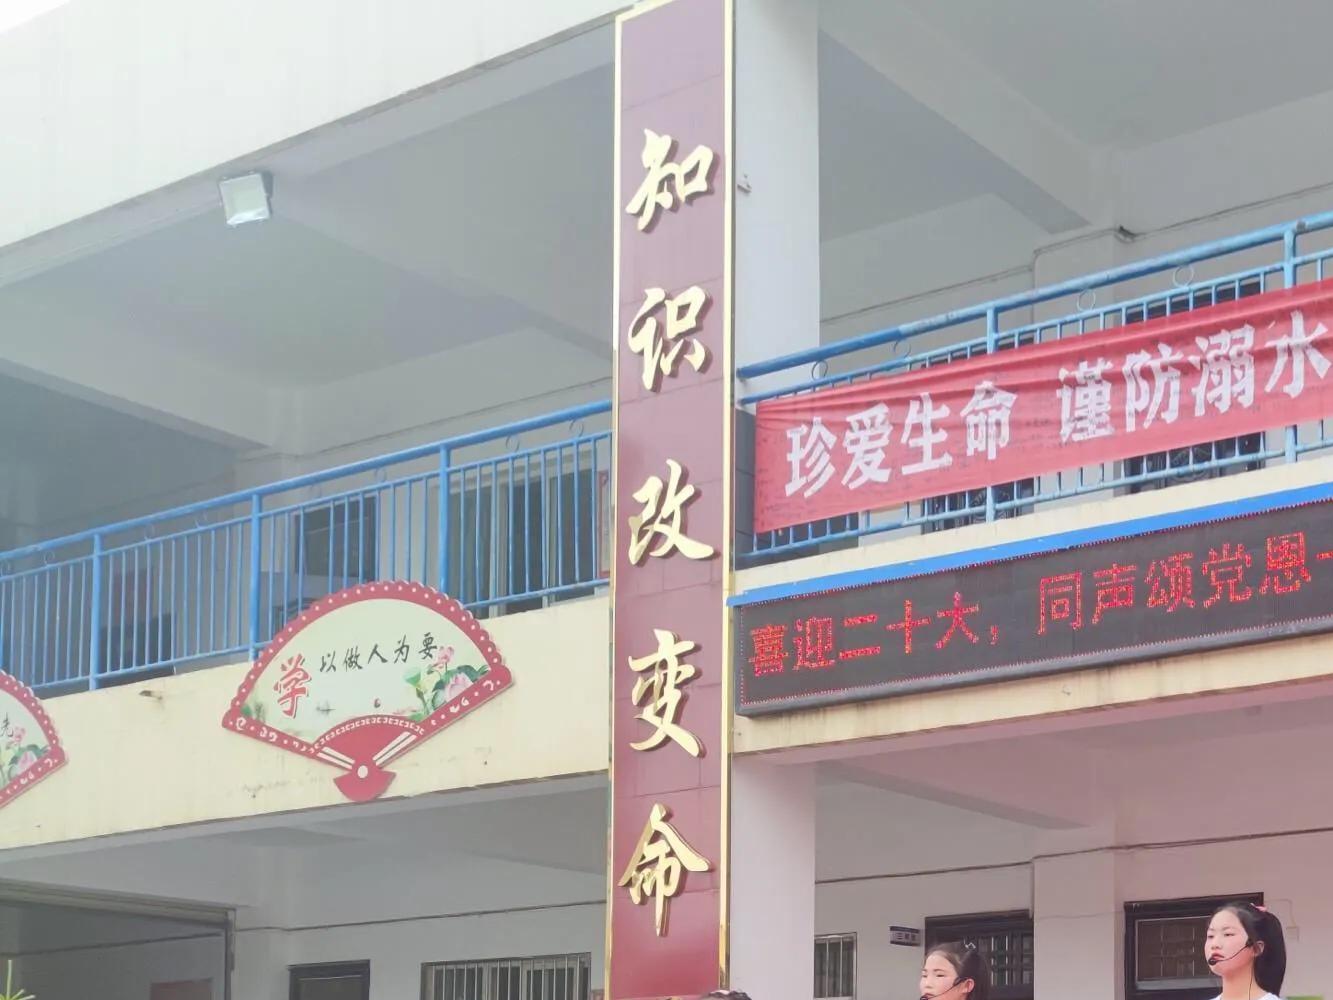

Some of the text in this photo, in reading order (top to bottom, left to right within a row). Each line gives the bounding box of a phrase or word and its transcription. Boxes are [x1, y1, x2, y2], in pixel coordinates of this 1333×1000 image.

[785, 381, 1017, 499] 珍爱生命
[1056, 311, 1332, 446] 谨防溺水
